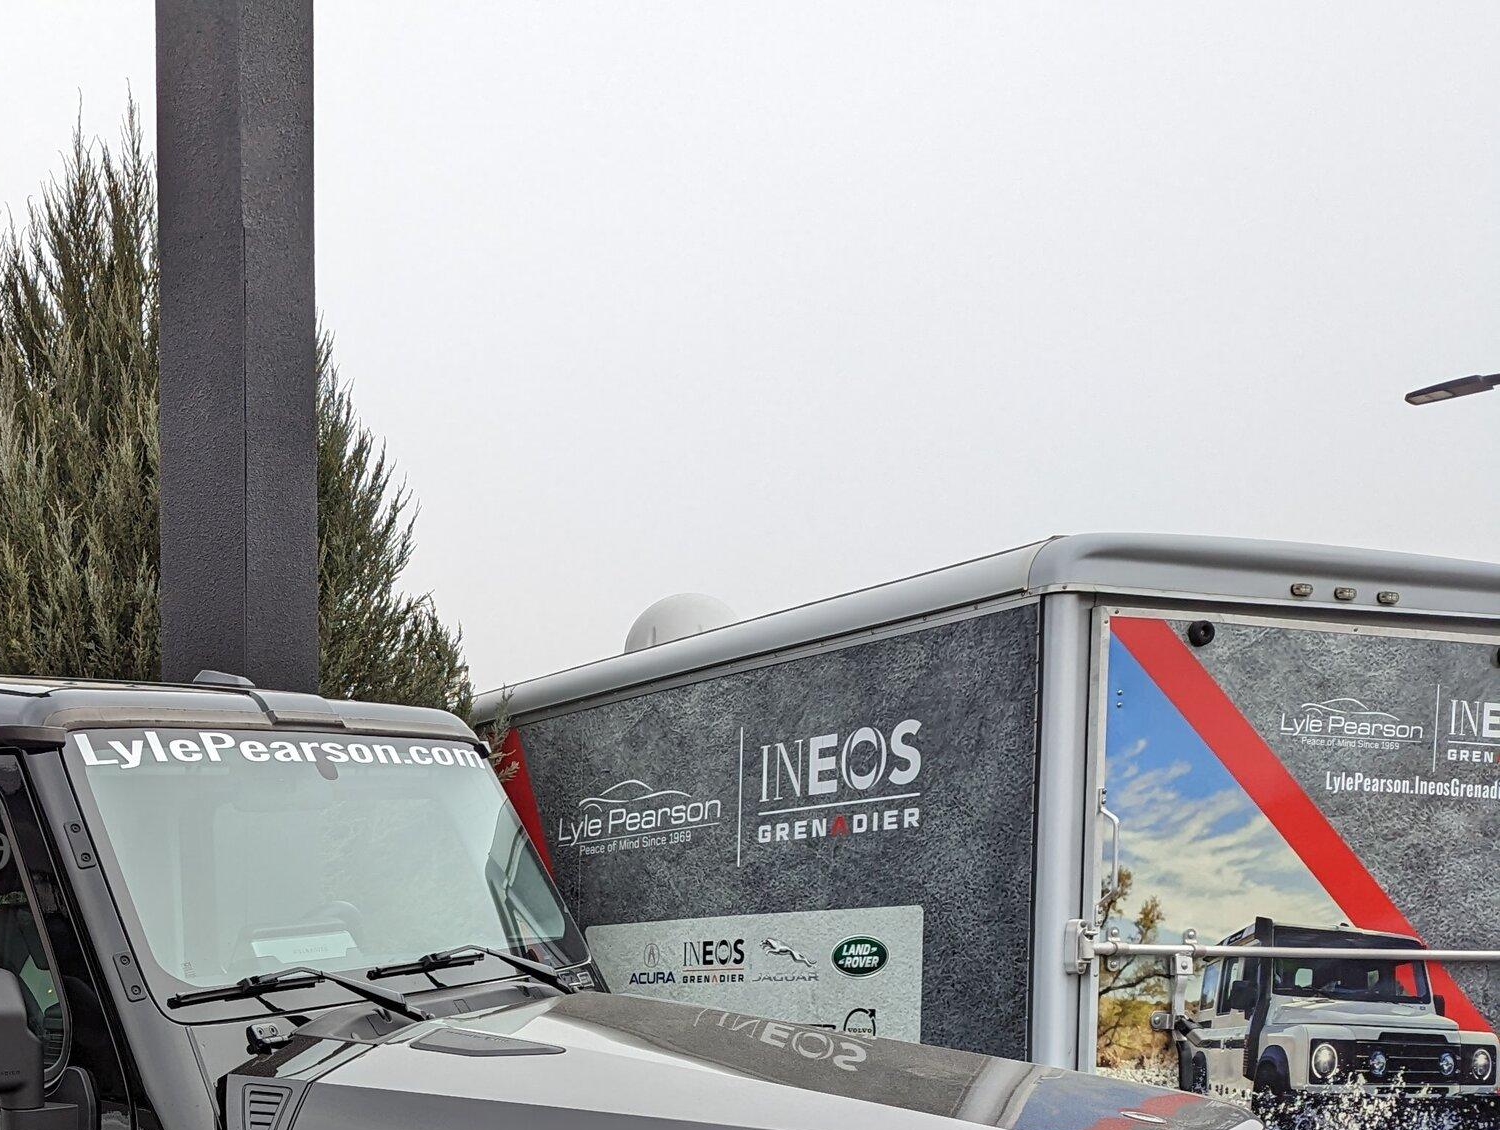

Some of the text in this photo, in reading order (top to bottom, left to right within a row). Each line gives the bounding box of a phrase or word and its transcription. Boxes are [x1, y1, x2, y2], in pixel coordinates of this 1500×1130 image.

[1280, 713, 1424, 739] Lyle Pearson
[1449, 699, 1500, 738] INE
[73, 730, 486, 769] LylePearson.com
[1301, 737, 1326, 746] Peace
[1326, 738, 1336, 747] of
[1337, 739, 1356, 748] Mind
[1358, 740, 1379, 749] Since
[1447, 749, 1500, 763] GREN
[759, 719, 923, 802] INEOS
[1326, 771, 1500, 800] LylePearson.IneosGrenadi
[558, 799, 721, 847] Lyle Pearson
[758, 807, 920, 843] GRENADIER
[579, 830, 692, 856] Peace of Mind Since 1969
[682, 938, 745, 967] INEOS
[841, 943, 871, 956] LAND
[843, 956, 880, 969] ROVER
[628, 971, 676, 985] ACURA
[682, 974, 745, 984] GRENADIER
[752, 971, 819, 982] JAGUAR
